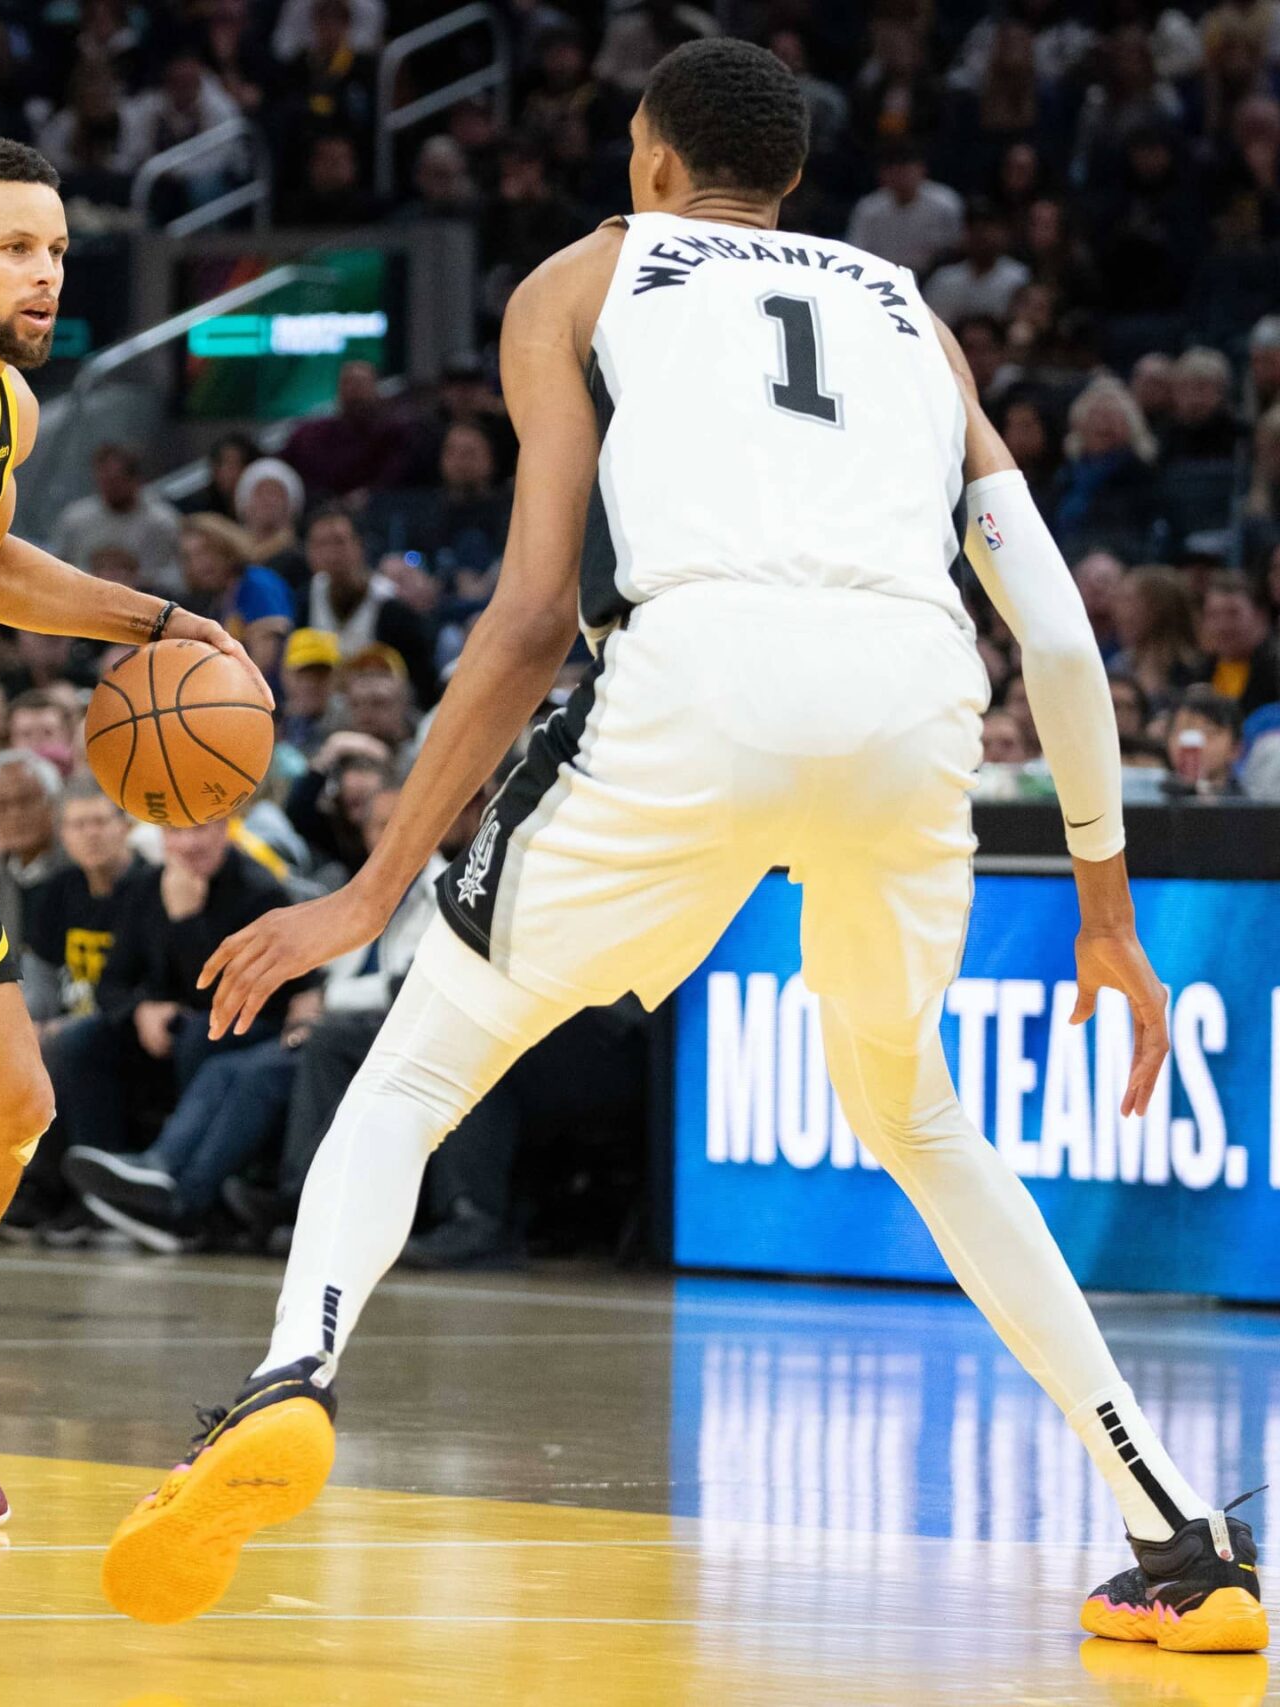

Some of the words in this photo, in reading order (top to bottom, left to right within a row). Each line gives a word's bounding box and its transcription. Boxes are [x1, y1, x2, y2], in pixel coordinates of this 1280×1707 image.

[632, 236, 920, 338] WEMBANYAMA
[756, 291, 844, 429] 1
[706, 971, 881, 1170] MO
[946, 978, 1249, 1190] TEAMS.
